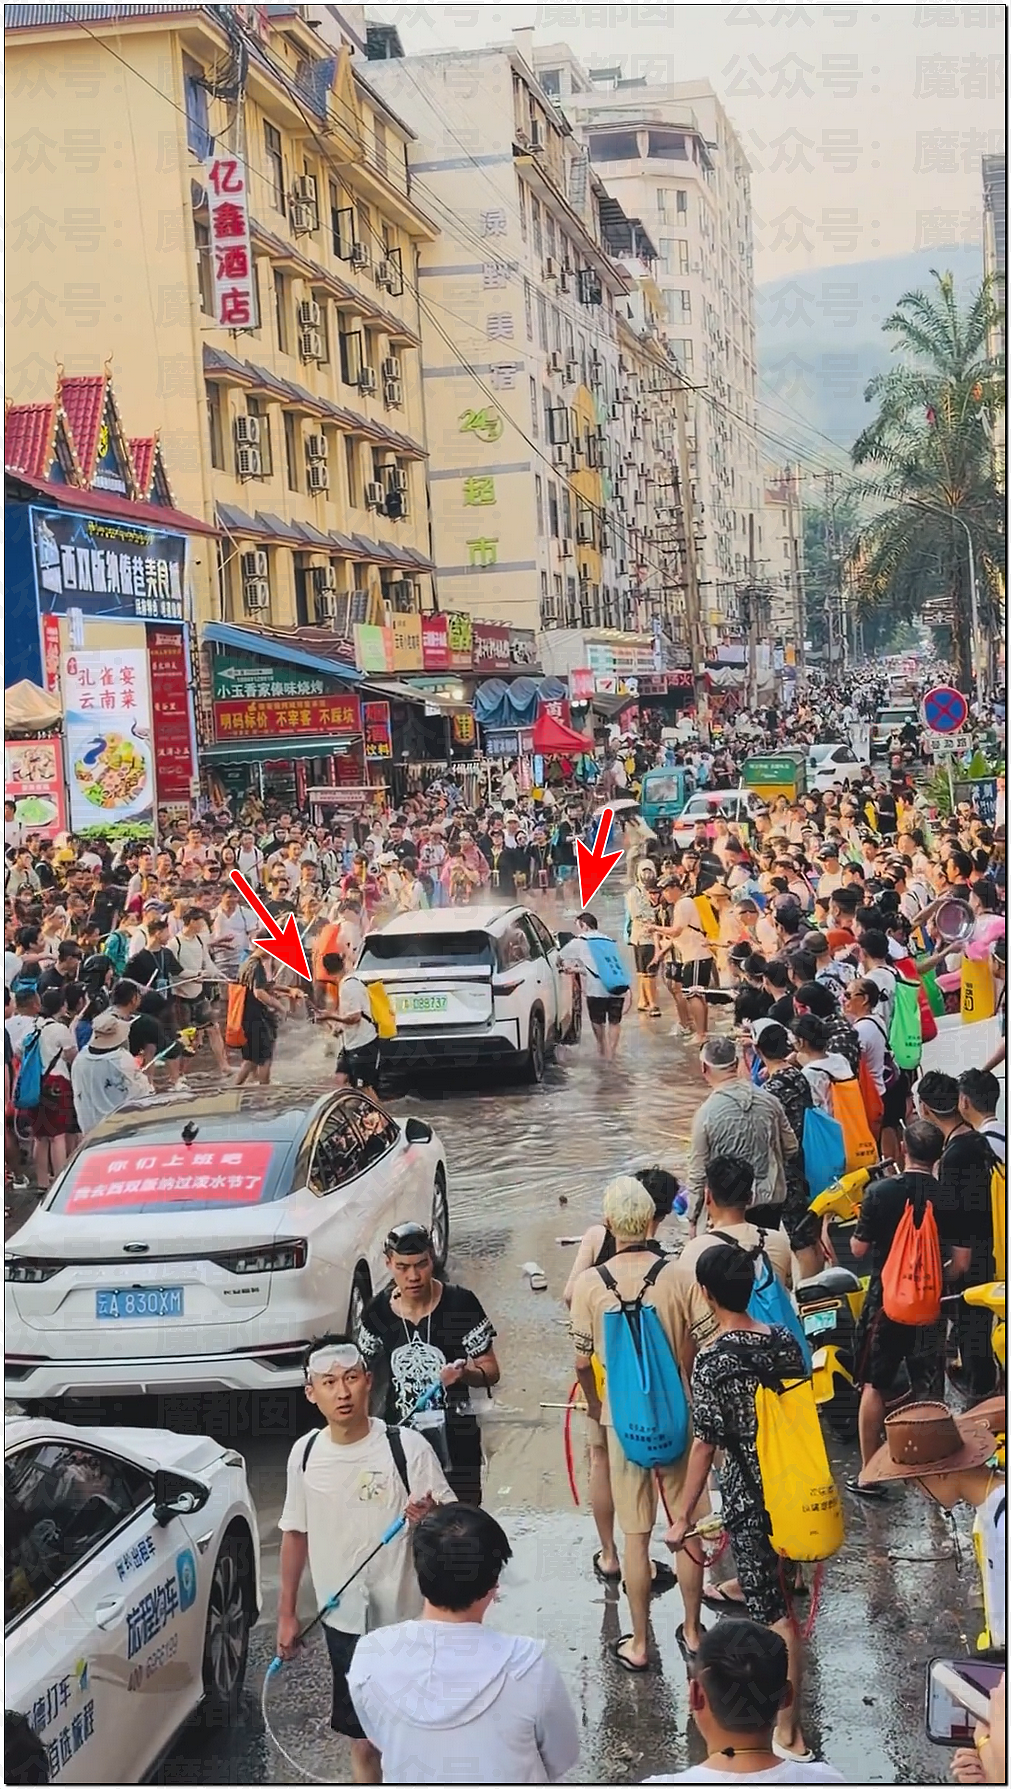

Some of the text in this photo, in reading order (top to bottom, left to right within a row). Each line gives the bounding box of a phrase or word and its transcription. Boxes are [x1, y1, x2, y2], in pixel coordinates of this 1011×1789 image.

[209, 158, 250, 325] 亿鑫酒店
[463, 475, 499, 568] 超市
[78, 666, 136, 686] 孔雀宴
[79, 690, 137, 709] 云南菜
[220, 711, 268, 730] 明码标价
[276, 709, 311, 727] 不宰客
[319, 706, 354, 725] 不踩坑
[107, 1153, 243, 1174] 你们上班吧
[73, 1175, 262, 1203] 我去西双版纳过泼水节了
[125, 1292, 181, 1314] 830XM
